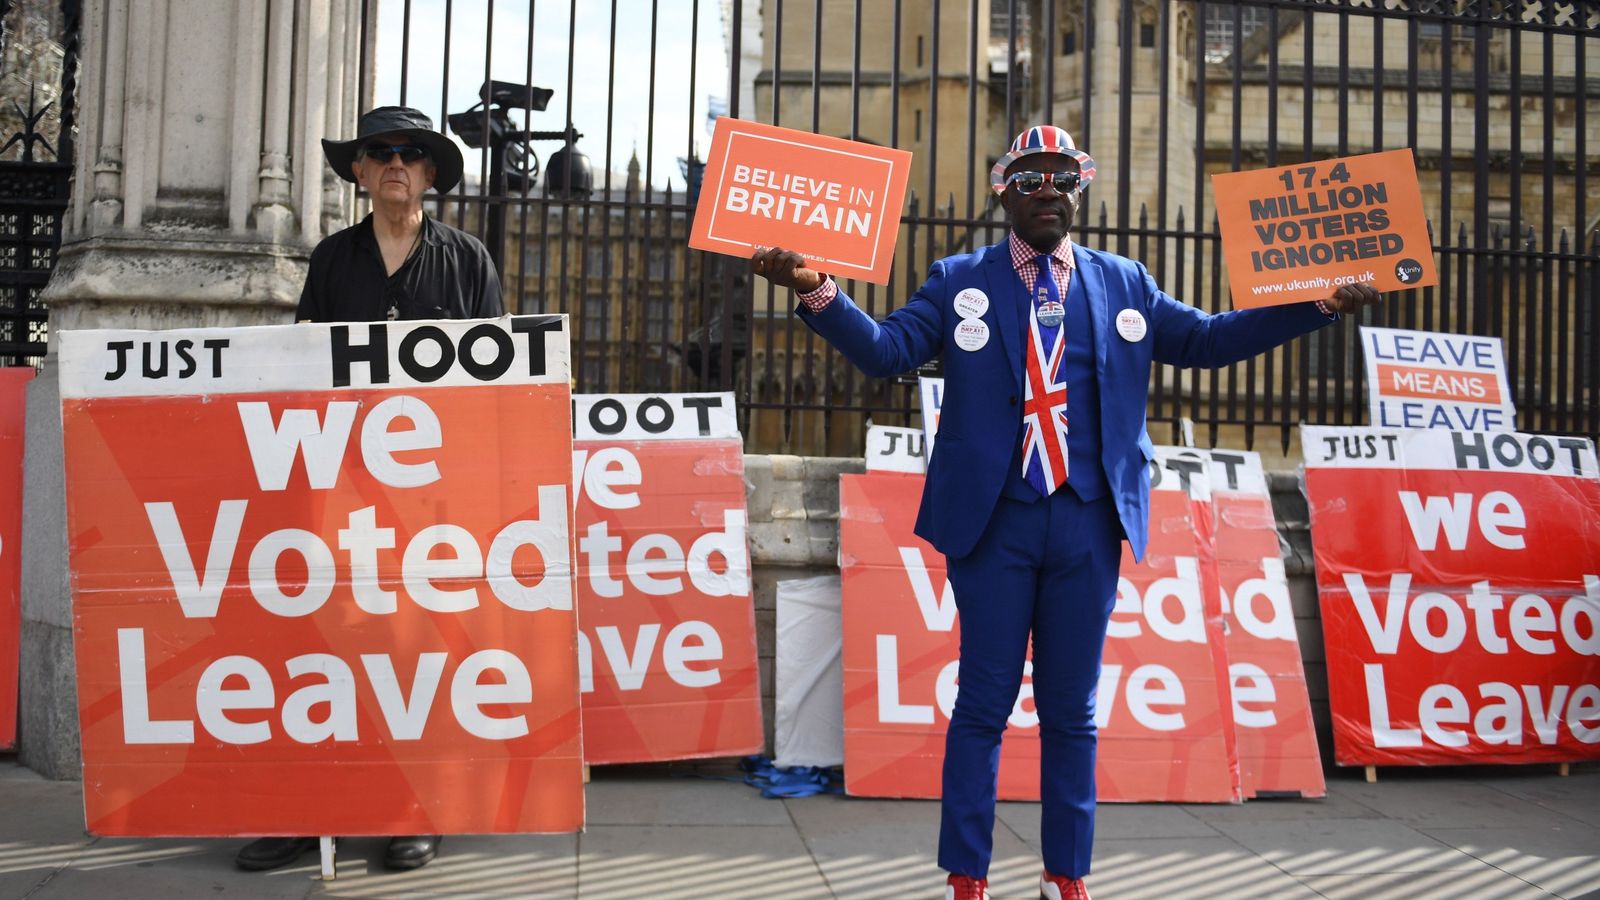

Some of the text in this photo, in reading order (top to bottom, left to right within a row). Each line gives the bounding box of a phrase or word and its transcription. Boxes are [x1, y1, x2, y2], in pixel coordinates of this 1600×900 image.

[733, 164, 875, 207] BELIEVE IN
[1279, 162, 1350, 190] 17.4
[725, 186, 872, 238] BRITAIN
[1249, 182, 1387, 221] MILLION
[1255, 208, 1390, 245] VOTERS
[1251, 233, 1404, 272] IGNORED
[104, 317, 562, 387] JUST HOOT
[1372, 333, 1495, 369] LEAVE
[1393, 370, 1486, 398] MEANS
[572, 397, 722, 436] OOT
[1380, 400, 1502, 431] LEAVE
[237, 396, 442, 491] we
[1323, 432, 1587, 476] JUST HOOT
[573, 447, 642, 509] e
[1399, 490, 1525, 551] we
[144, 485, 573, 618] Voted
[580, 509, 749, 597] ted
[1342, 573, 1600, 656] Voted
[117, 628, 532, 744] Leave
[1364, 663, 1600, 748] Leave
